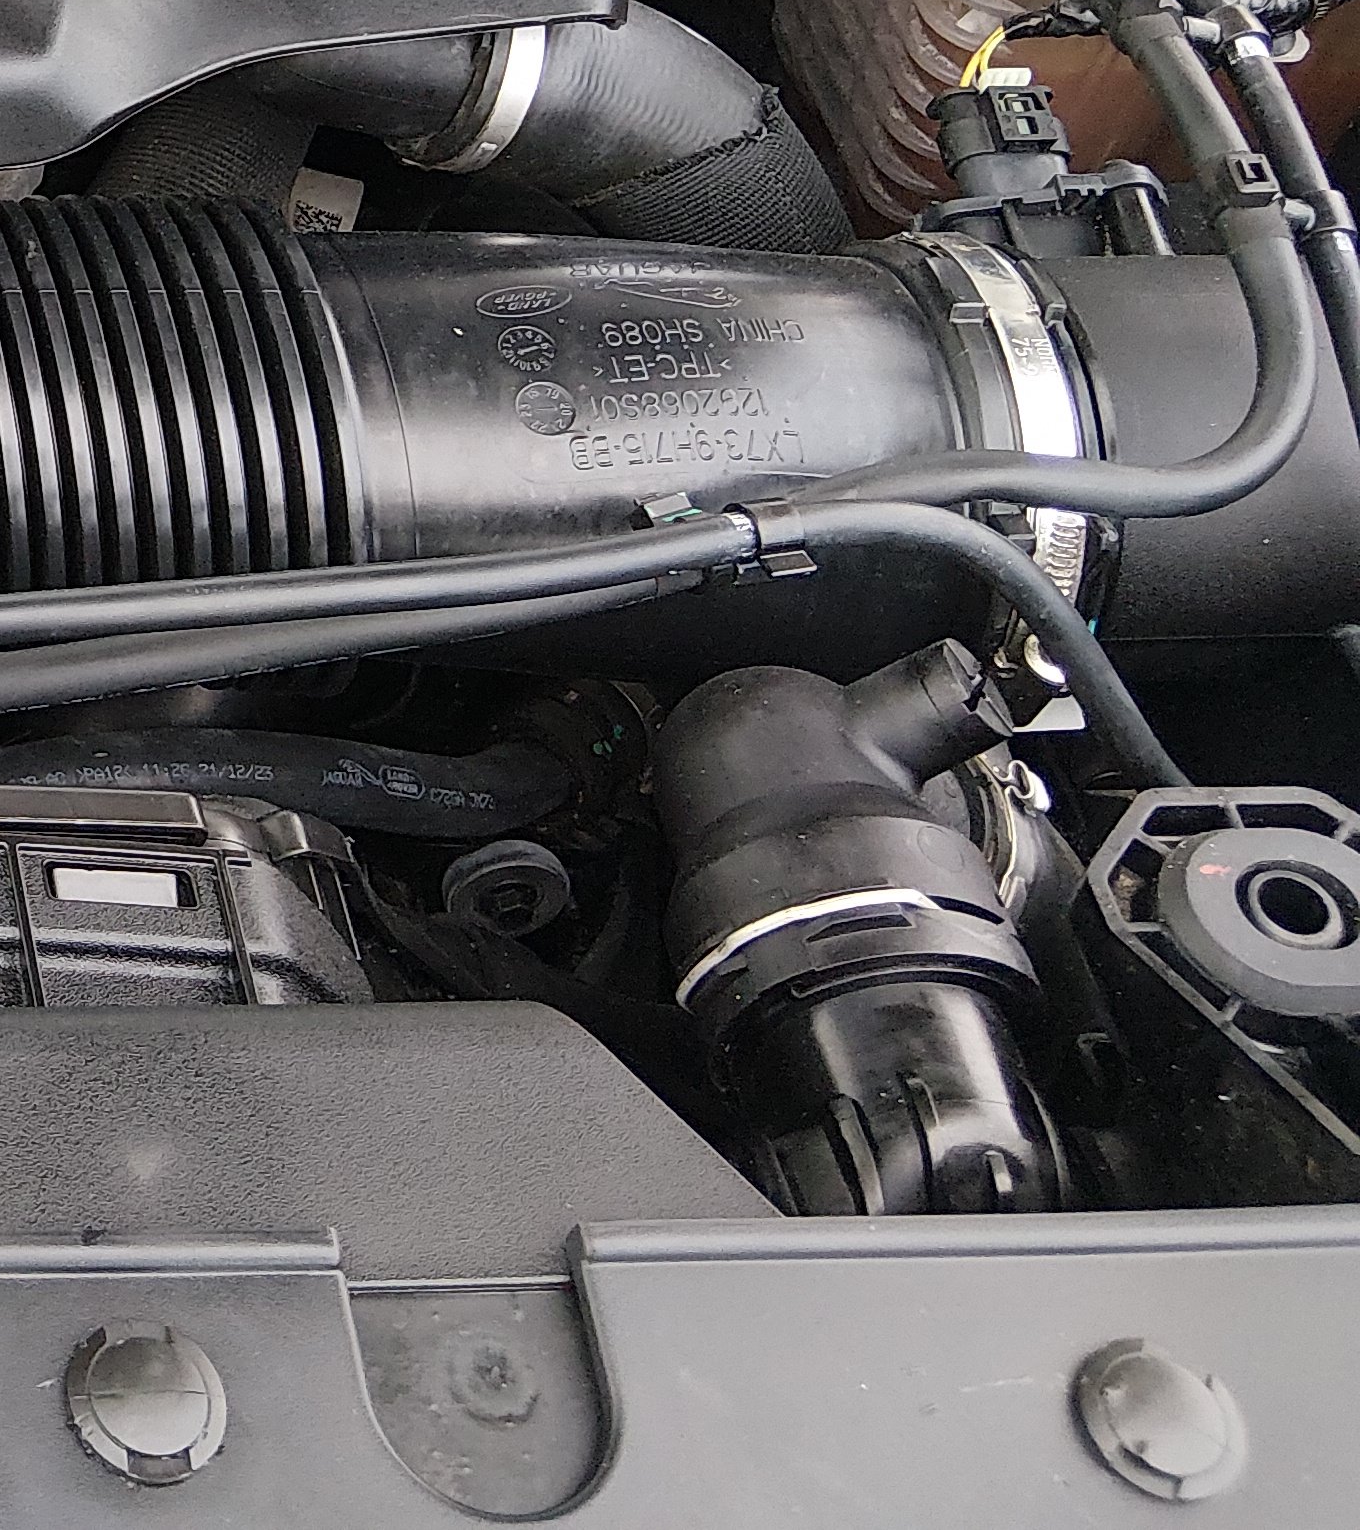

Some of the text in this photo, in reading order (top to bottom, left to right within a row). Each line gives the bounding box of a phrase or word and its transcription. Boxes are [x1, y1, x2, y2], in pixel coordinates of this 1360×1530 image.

[569, 261, 712, 279] JAGUAR
[600, 316, 805, 348] CHINA SH089
[568, 427, 805, 472] LX73-9H715-BB
